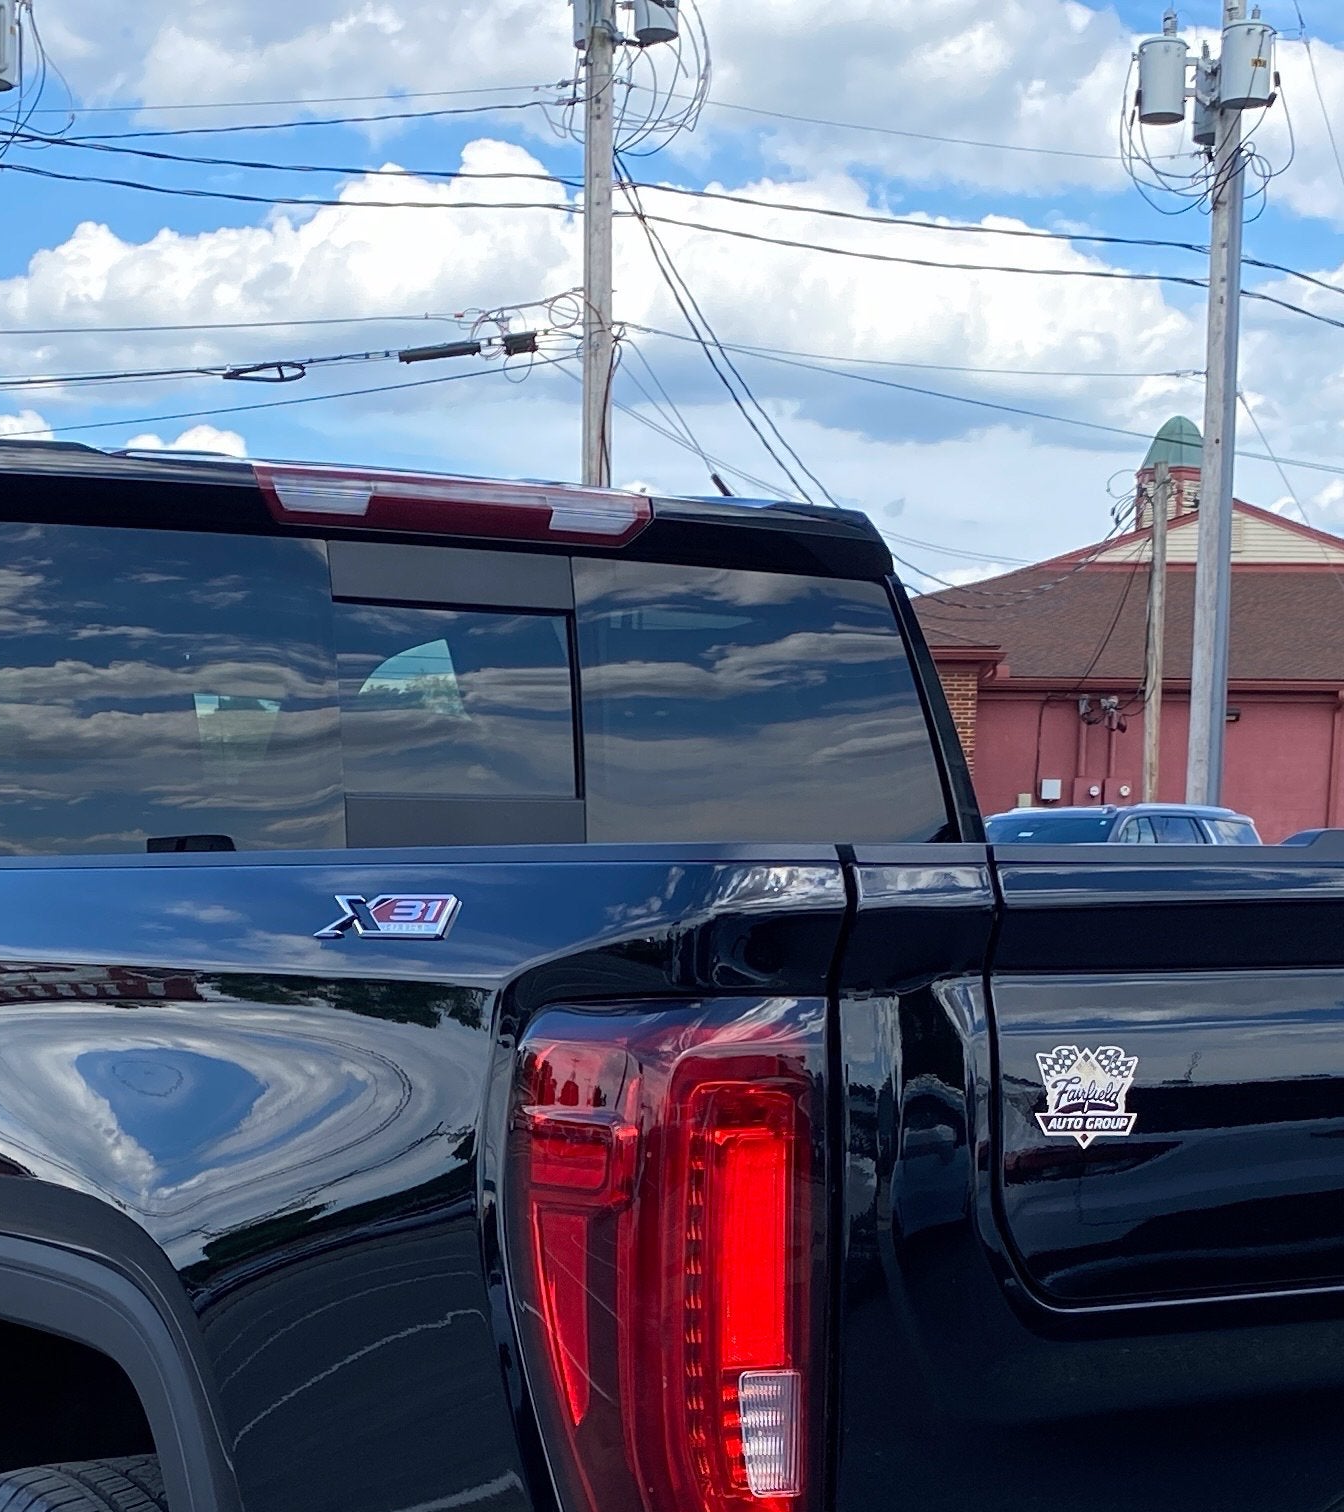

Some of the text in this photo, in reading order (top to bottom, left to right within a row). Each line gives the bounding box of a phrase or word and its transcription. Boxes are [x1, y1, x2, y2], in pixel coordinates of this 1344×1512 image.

[313, 894, 444, 938] X31
[1051, 1076, 1124, 1113] Fairfield
[1047, 1117, 1128, 1130] AUTO GROUP
